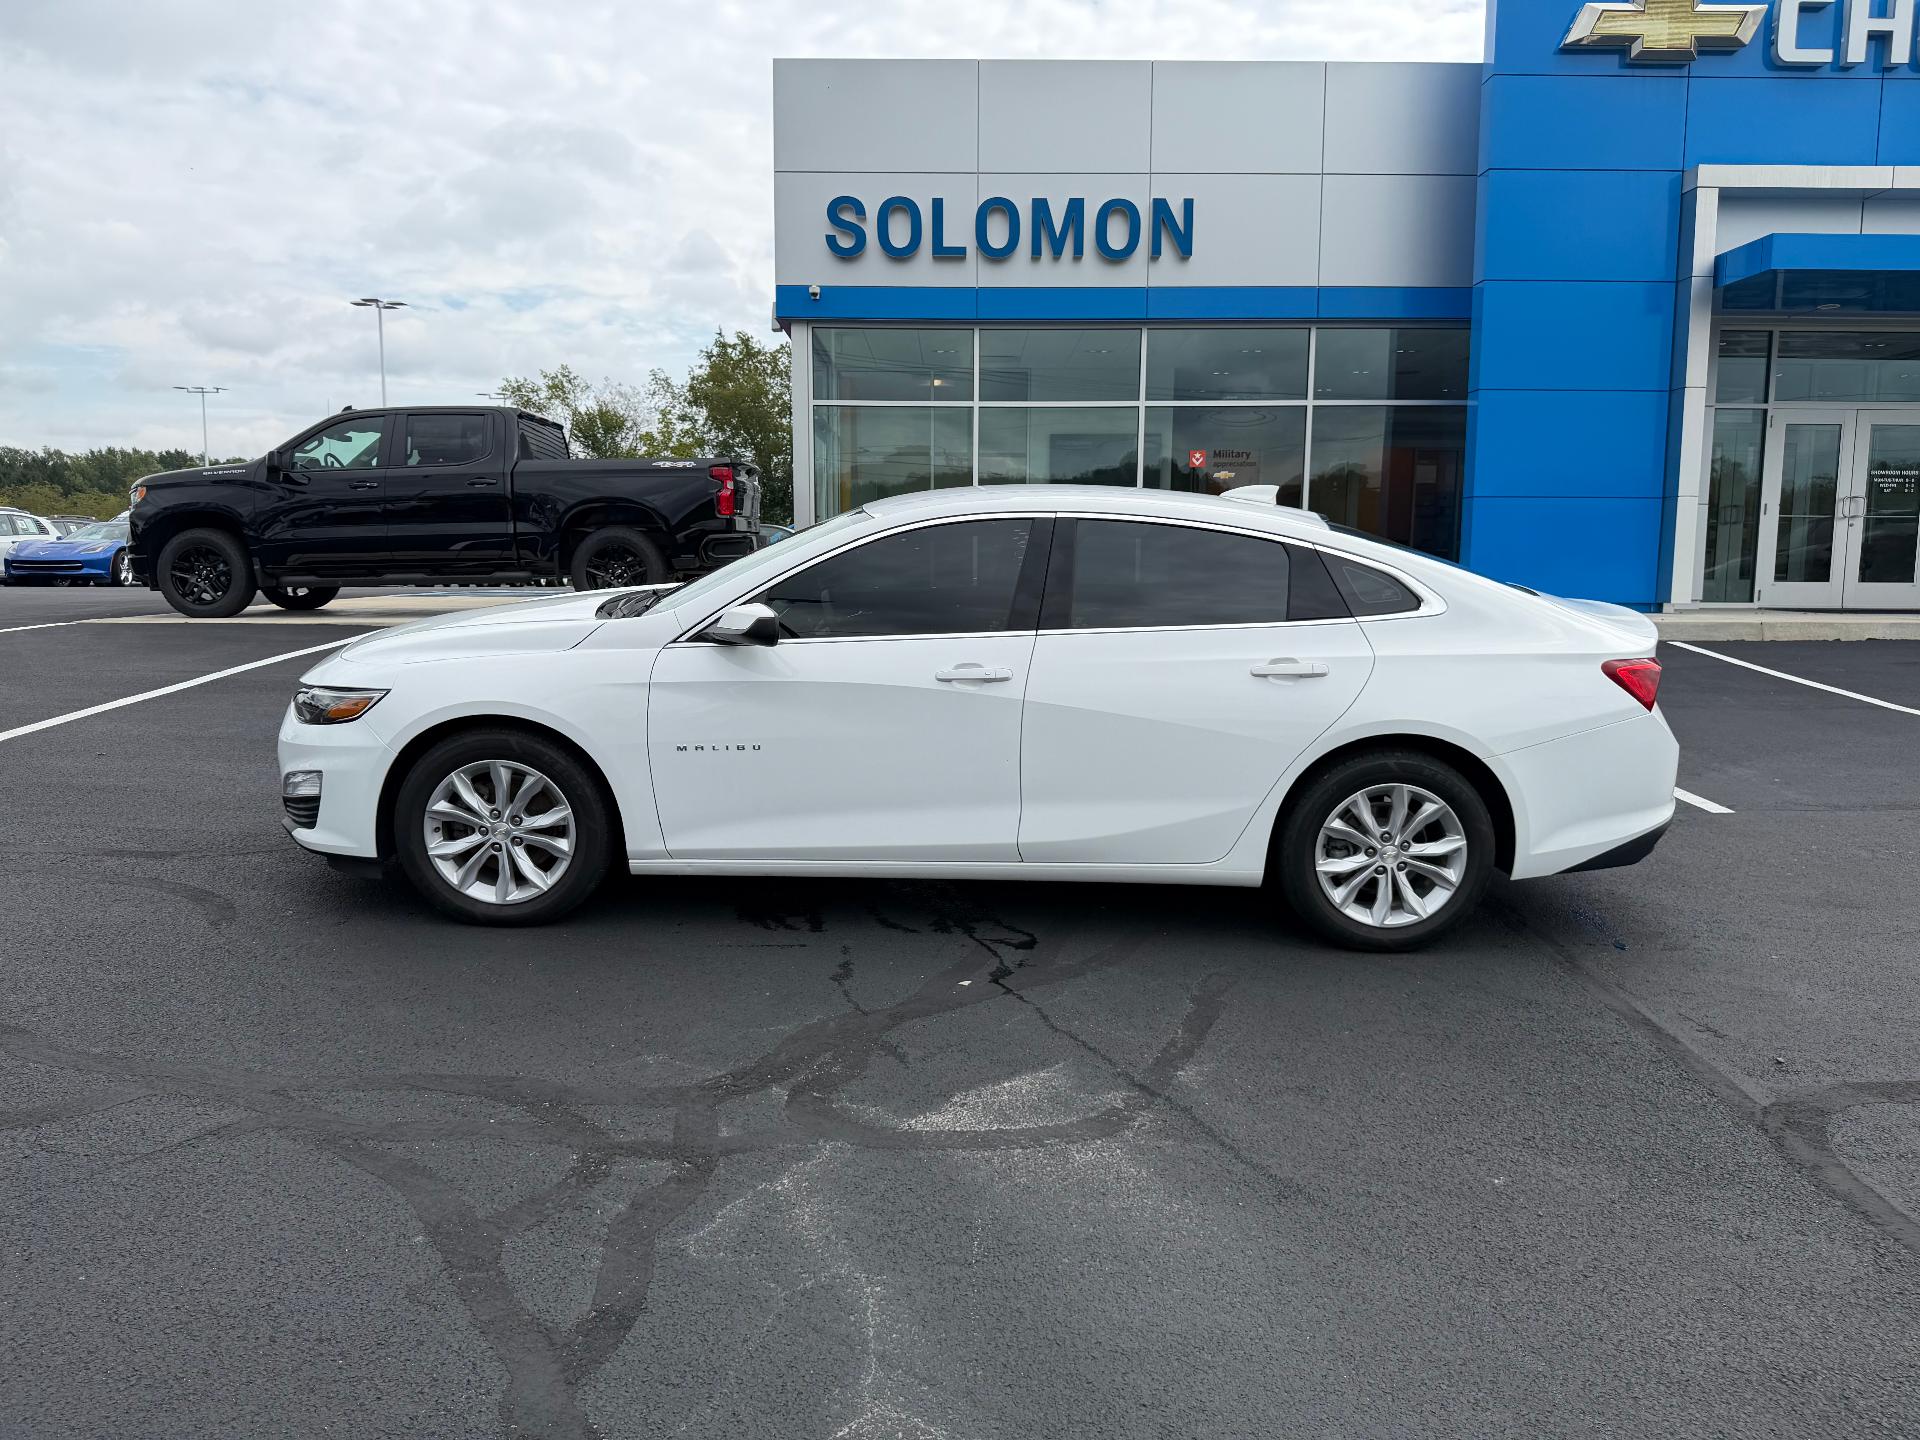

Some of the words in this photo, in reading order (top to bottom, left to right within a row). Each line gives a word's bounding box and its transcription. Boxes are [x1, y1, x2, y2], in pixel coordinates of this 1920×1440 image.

[824, 195, 1195, 260] SOLOMON
[1213, 450, 1251, 459] Military
[676, 743, 761, 751] MALIBU
